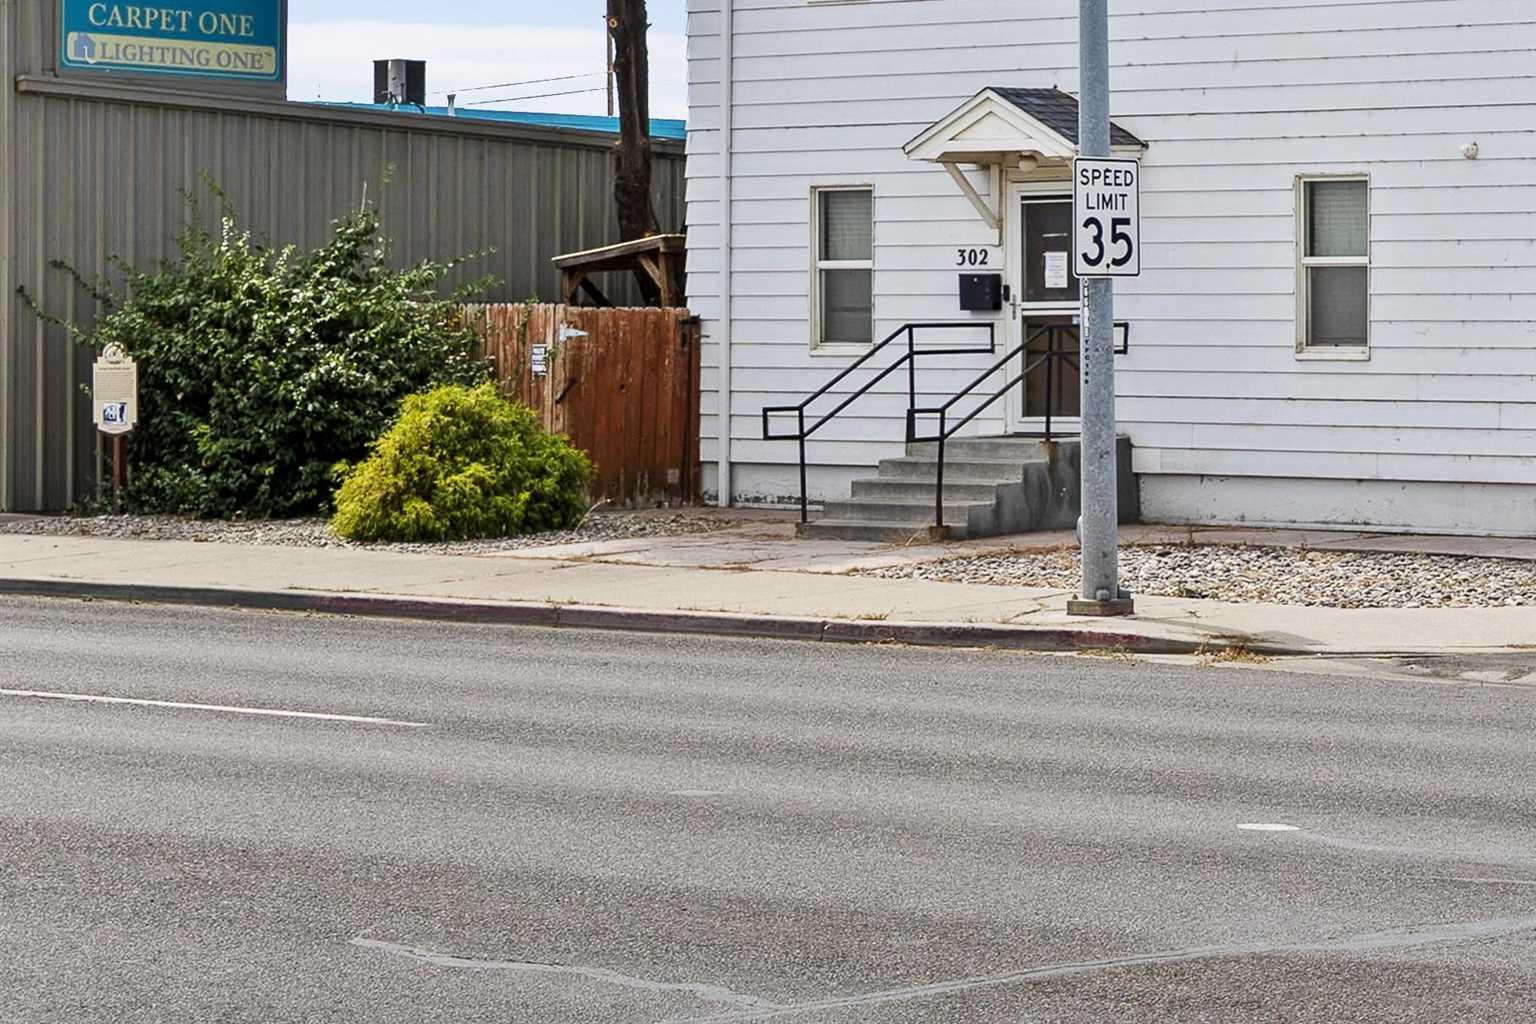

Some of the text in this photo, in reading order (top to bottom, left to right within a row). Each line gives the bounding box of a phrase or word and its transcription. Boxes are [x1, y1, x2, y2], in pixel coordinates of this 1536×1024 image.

[88, 2, 254, 37] CARPET ONE
[100, 42, 210, 67] LIGHTING
[1080, 168, 1134, 187] SPEED
[1086, 193, 1128, 210] LIMIT
[1081, 216, 1133, 267] 35
[956, 249, 988, 266] 302
